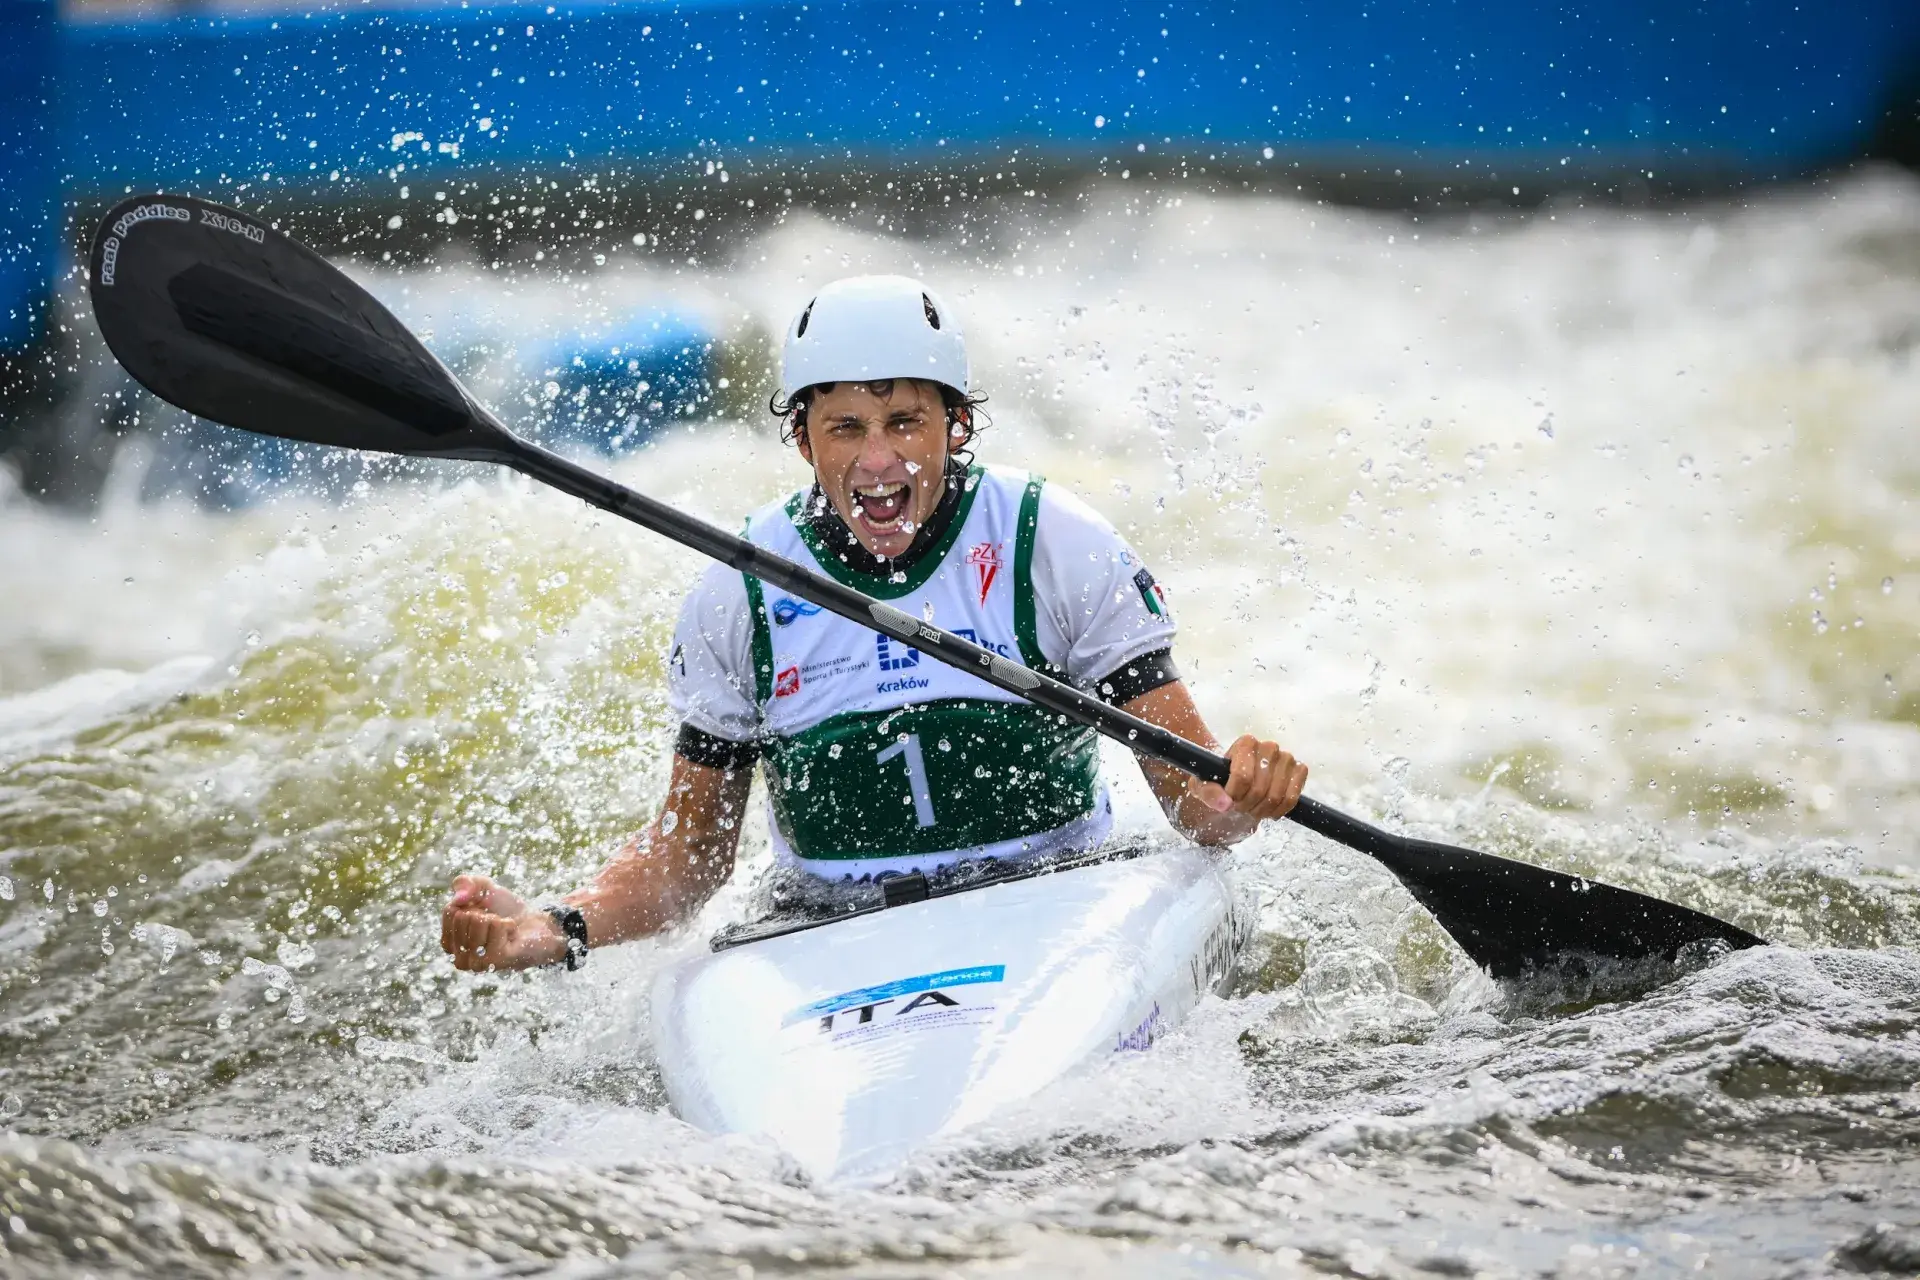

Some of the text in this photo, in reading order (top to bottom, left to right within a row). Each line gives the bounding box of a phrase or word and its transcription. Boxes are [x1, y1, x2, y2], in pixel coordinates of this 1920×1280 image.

[102, 204, 265, 285] raab paddles X16-M
[919, 626, 941, 645] raa
[801, 656, 852, 674] Ministerstwo
[803, 673, 827, 684] Sportu
[835, 660, 870, 675] Turystyki
[877, 676, 929, 694] Kraków
[877, 733, 936, 828] 1
[818, 991, 961, 1035] ITA
